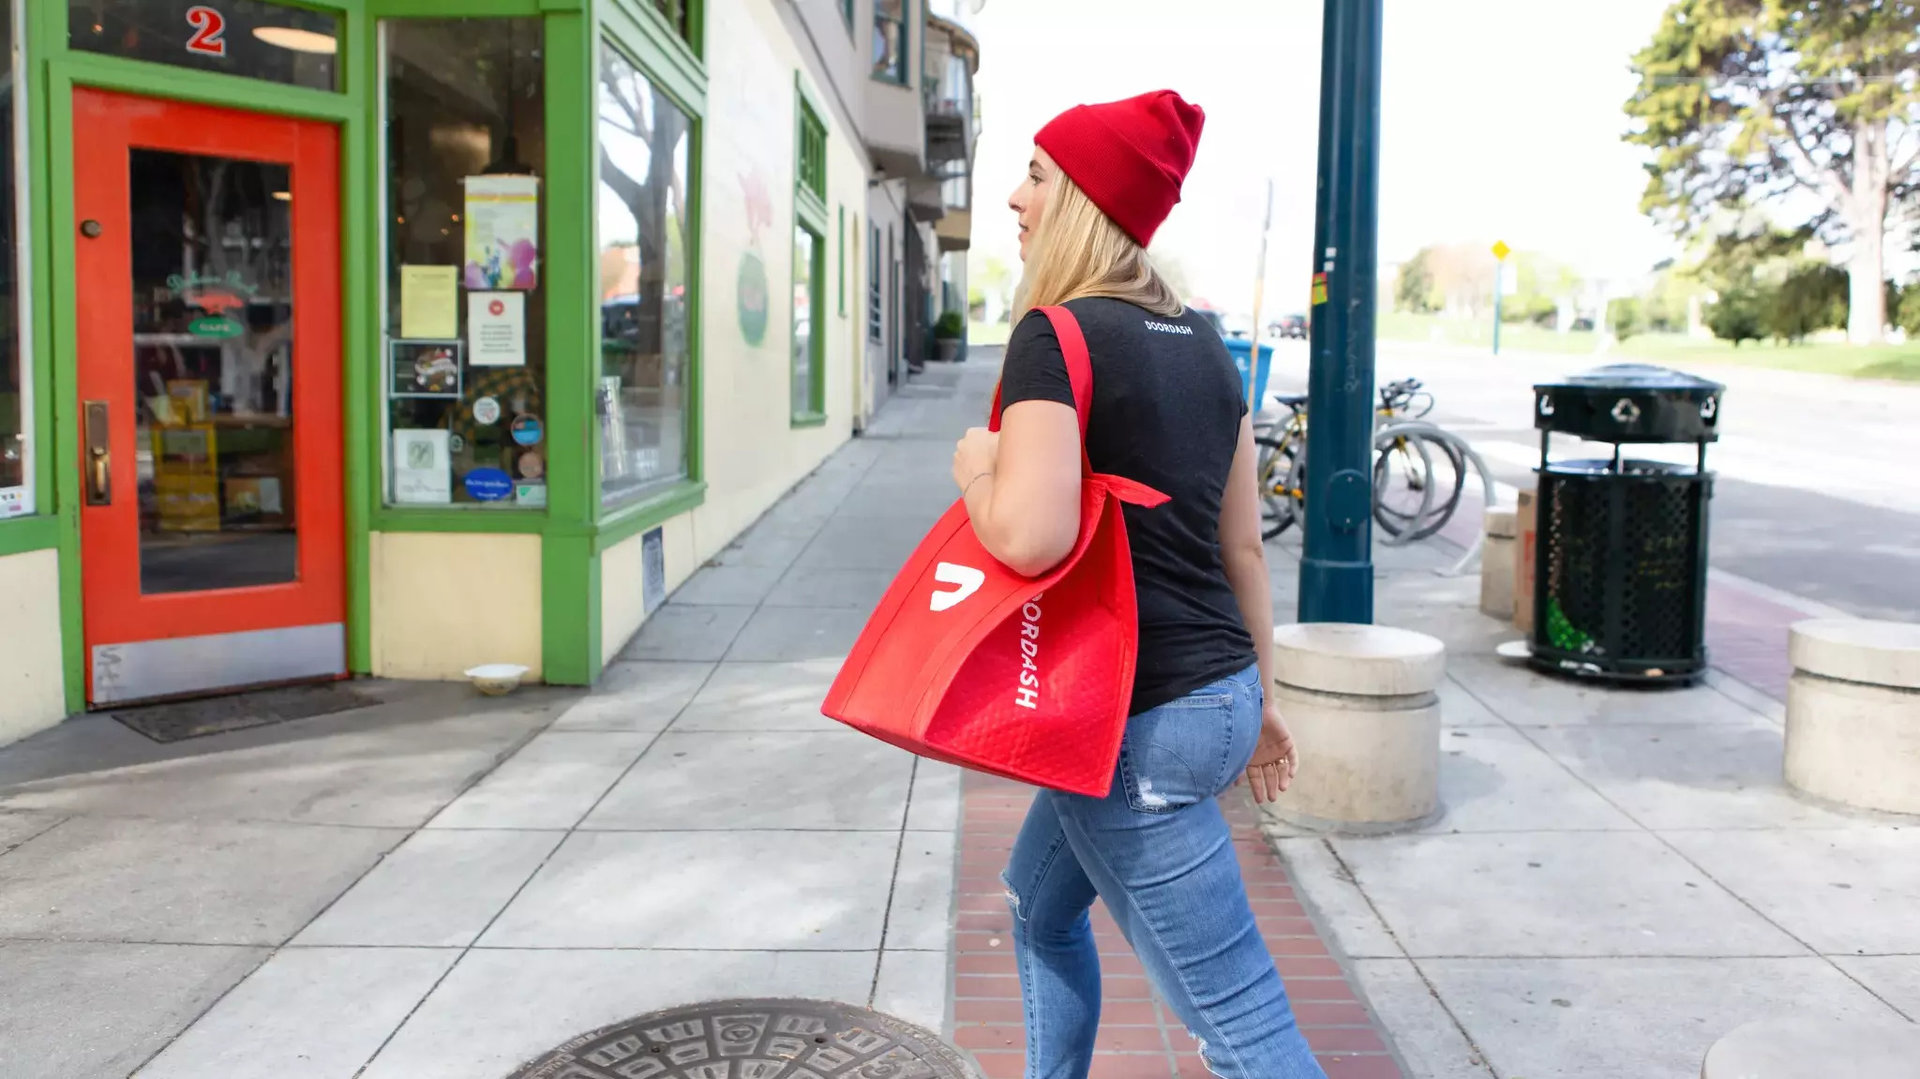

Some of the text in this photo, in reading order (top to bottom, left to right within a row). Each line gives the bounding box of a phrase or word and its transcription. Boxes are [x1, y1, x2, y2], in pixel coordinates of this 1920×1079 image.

[186, 5, 225, 56] 2
[1144, 320, 1193, 335] DOORDASH
[1015, 591, 1044, 709] ORDASH
